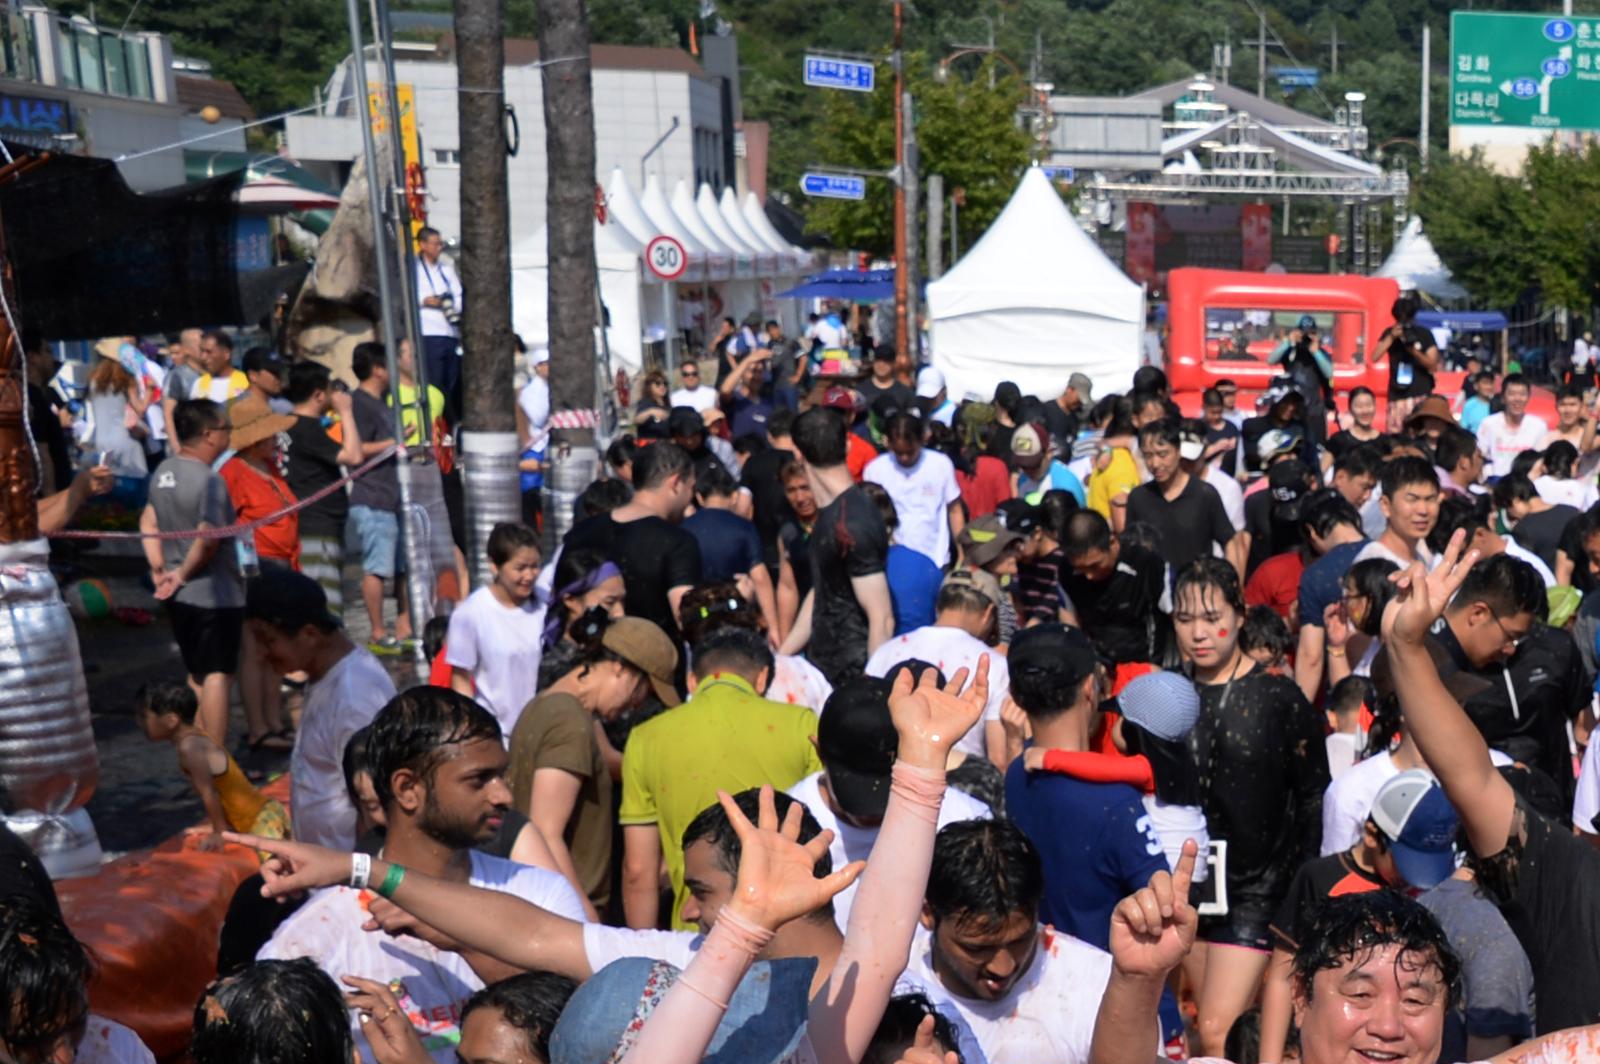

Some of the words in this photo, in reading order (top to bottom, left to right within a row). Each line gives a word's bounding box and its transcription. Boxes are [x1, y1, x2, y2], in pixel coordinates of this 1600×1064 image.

[1553, 23, 1564, 37] 5
[1457, 54, 1490, 73] 김화
[1515, 81, 1534, 95] 56
[1455, 91, 1500, 108] 다목리
[1530, 114, 1561, 126] 200m
[655, 245, 678, 268] 30
